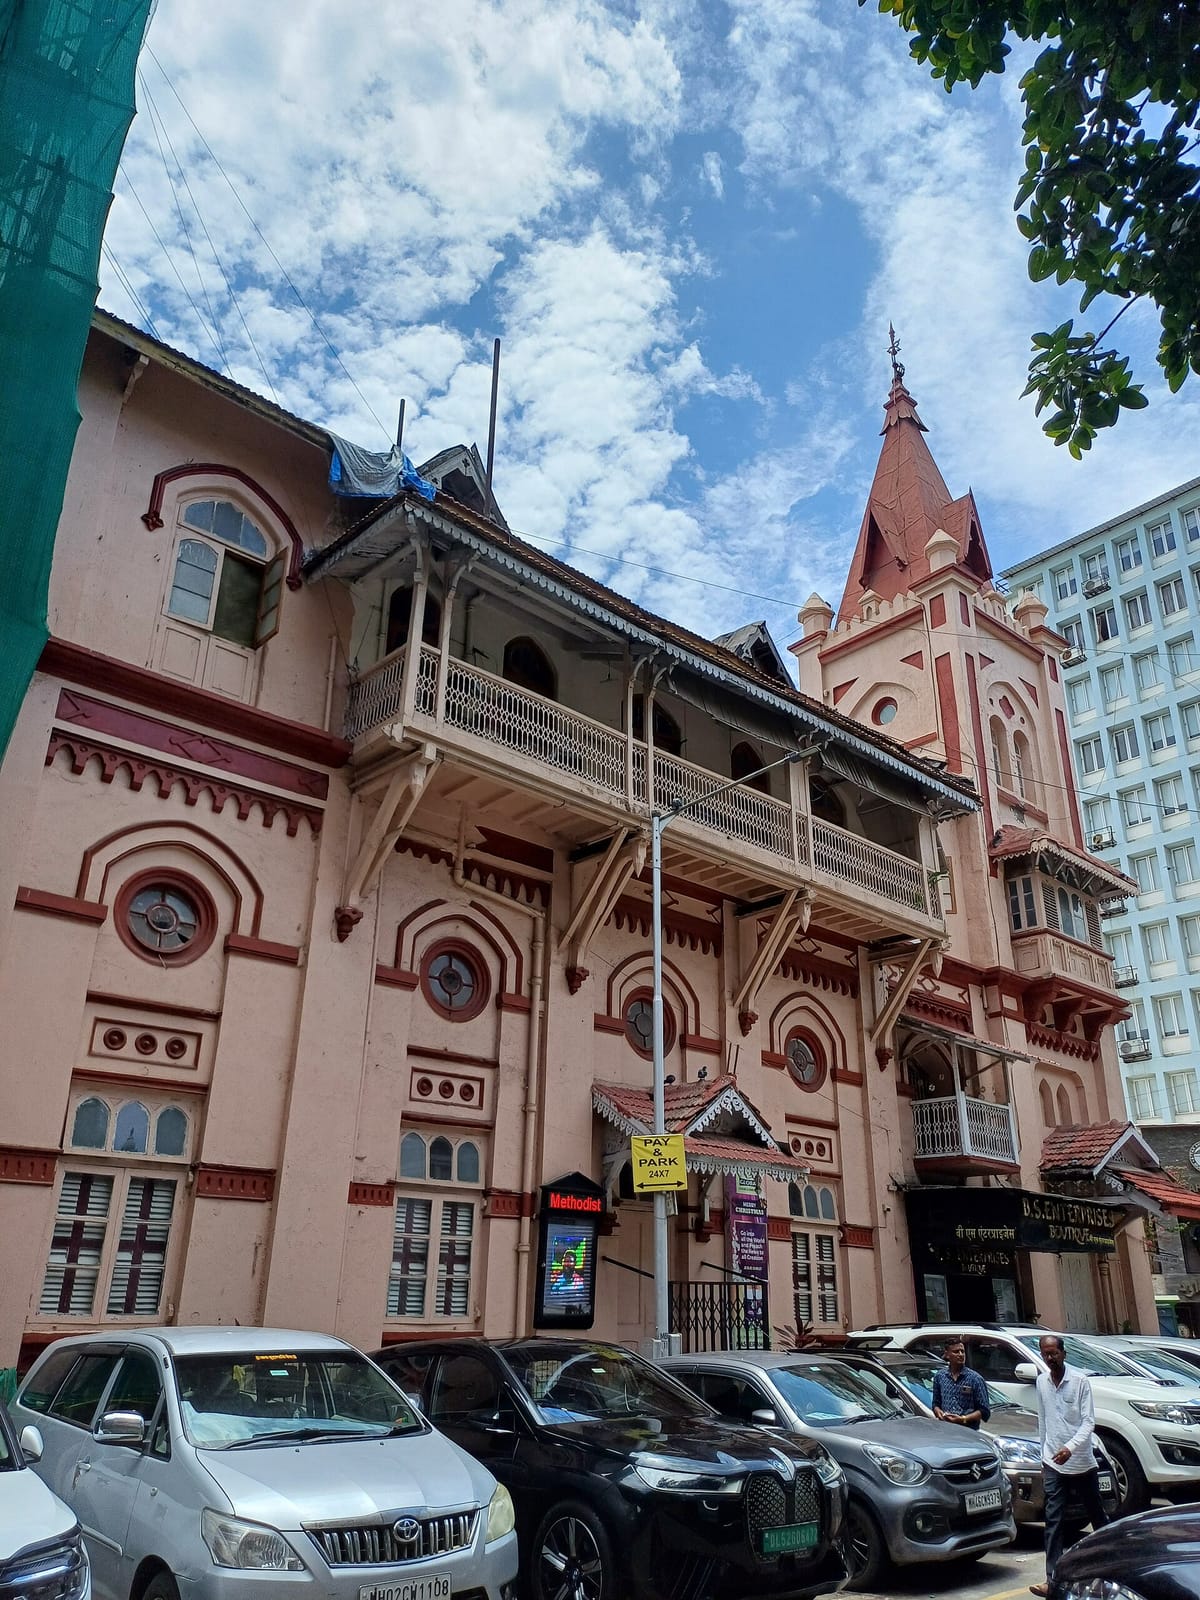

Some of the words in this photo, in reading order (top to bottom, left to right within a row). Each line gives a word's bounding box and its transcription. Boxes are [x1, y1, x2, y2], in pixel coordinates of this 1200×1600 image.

[644, 1138, 670, 1147] PAY
[653, 1148, 662, 1156] &
[639, 1157, 678, 1167] PARK
[648, 1169, 670, 1178] 24X7
[550, 1192, 602, 1212] Methodist
[735, 1207, 764, 1215] CHRISTMAS
